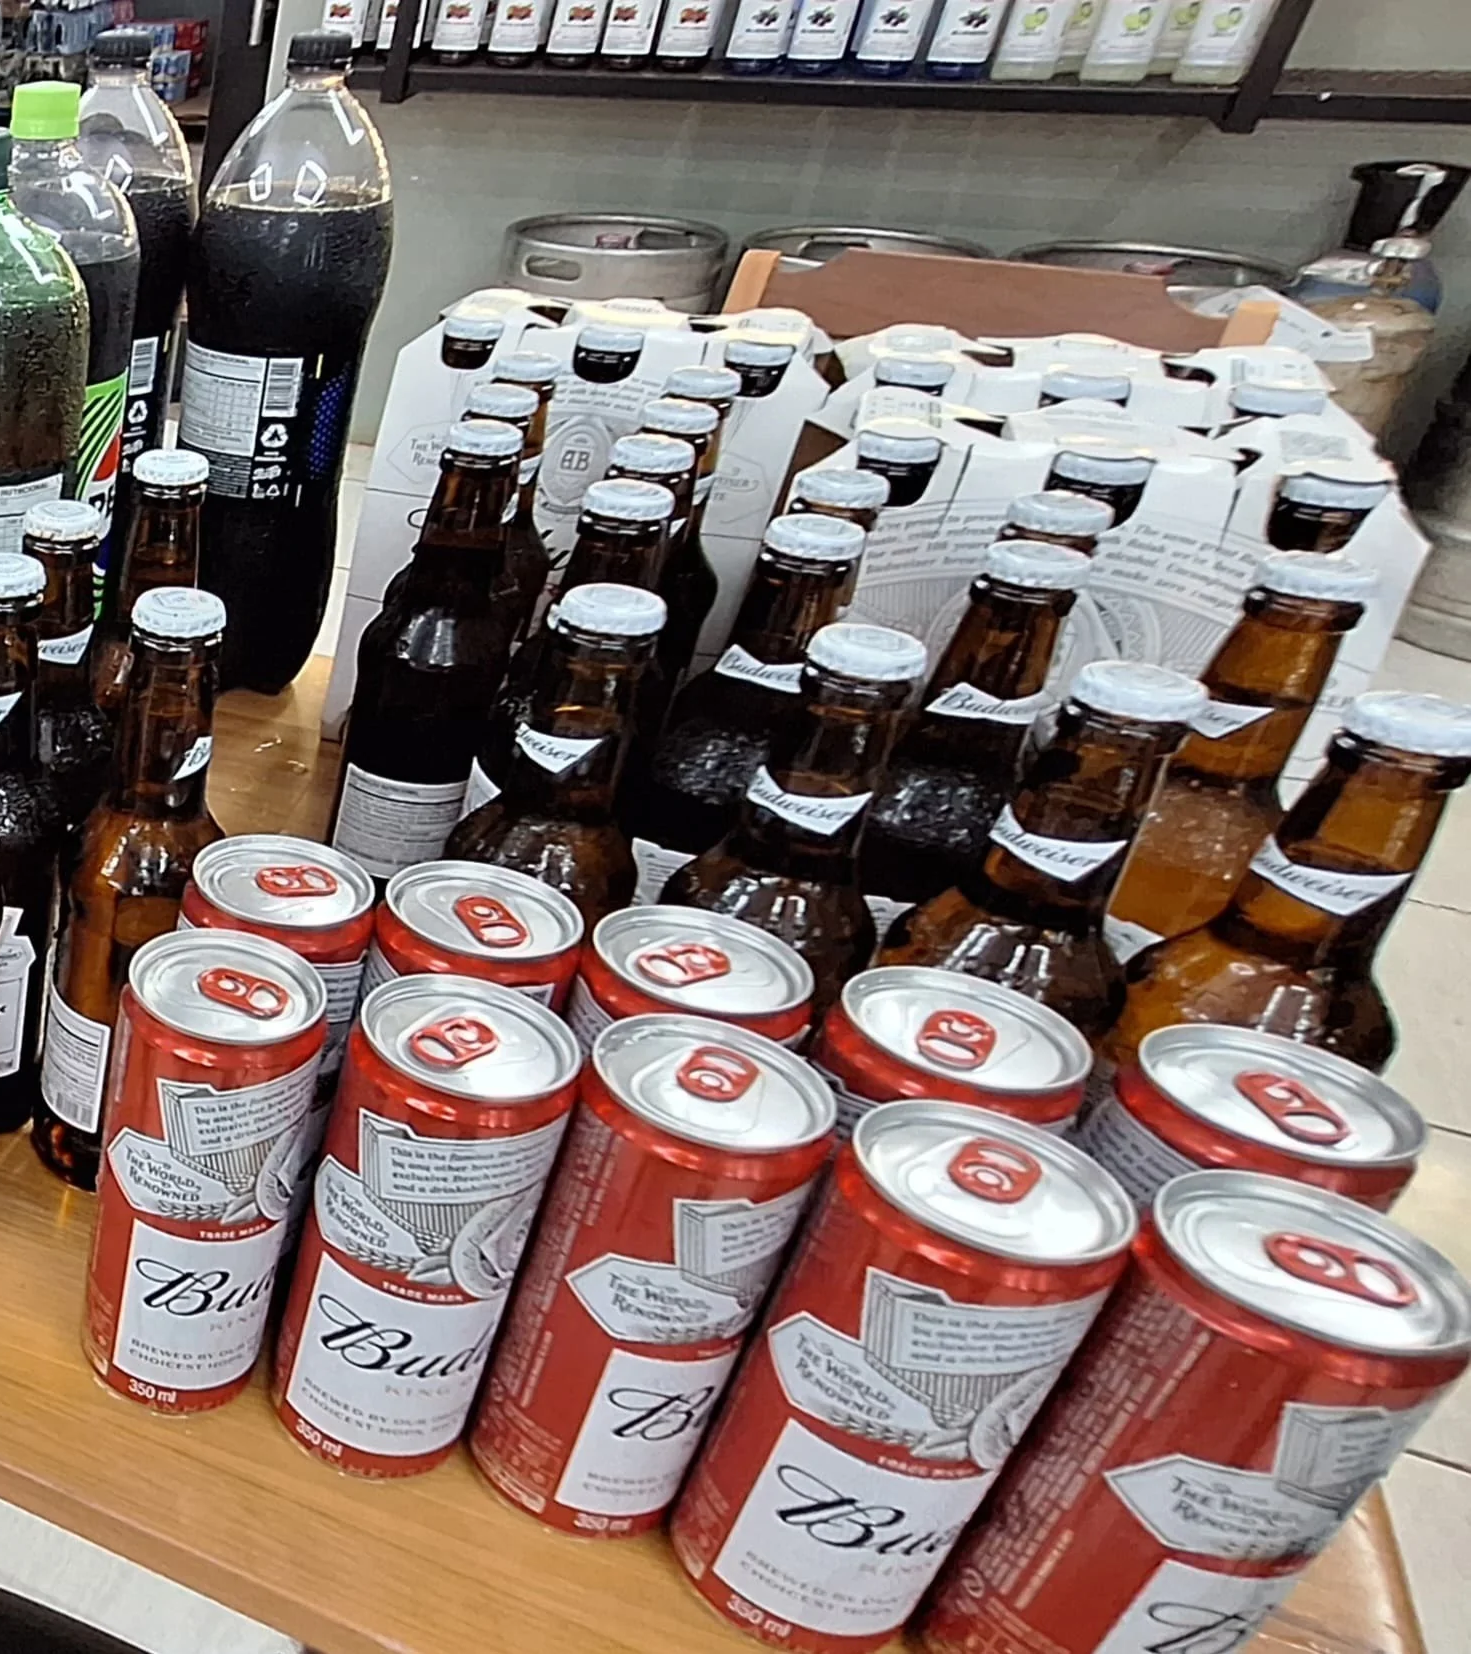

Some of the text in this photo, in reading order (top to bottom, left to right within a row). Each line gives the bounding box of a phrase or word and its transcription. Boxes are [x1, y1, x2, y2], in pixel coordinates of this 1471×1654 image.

[194, 1105, 217, 1115] This
[230, 1101, 247, 1111] the
[198, 1121, 250, 1135] exclusive
[200, 1135, 222, 1145] and
[125, 1146, 146, 1172] THE
[390, 1146, 413, 1158] This
[428, 1152, 447, 1162] the
[130, 1165, 200, 1202] RENOWNED
[199, 1229, 236, 1240] TRADE
[381, 1281, 423, 1300] TRADE
[607, 1272, 638, 1299] THE
[129, 1348, 204, 1371] CHOICEST
[131, 1337, 194, 1360] BREWED
[795, 1333, 821, 1369] THE
[128, 1378, 178, 1403] 350 ml
[304, 1376, 364, 1418] BREWED
[795, 1357, 890, 1421] RENOWNED
[295, 1417, 344, 1458] 350 ml
[573, 1511, 608, 1531] 350
